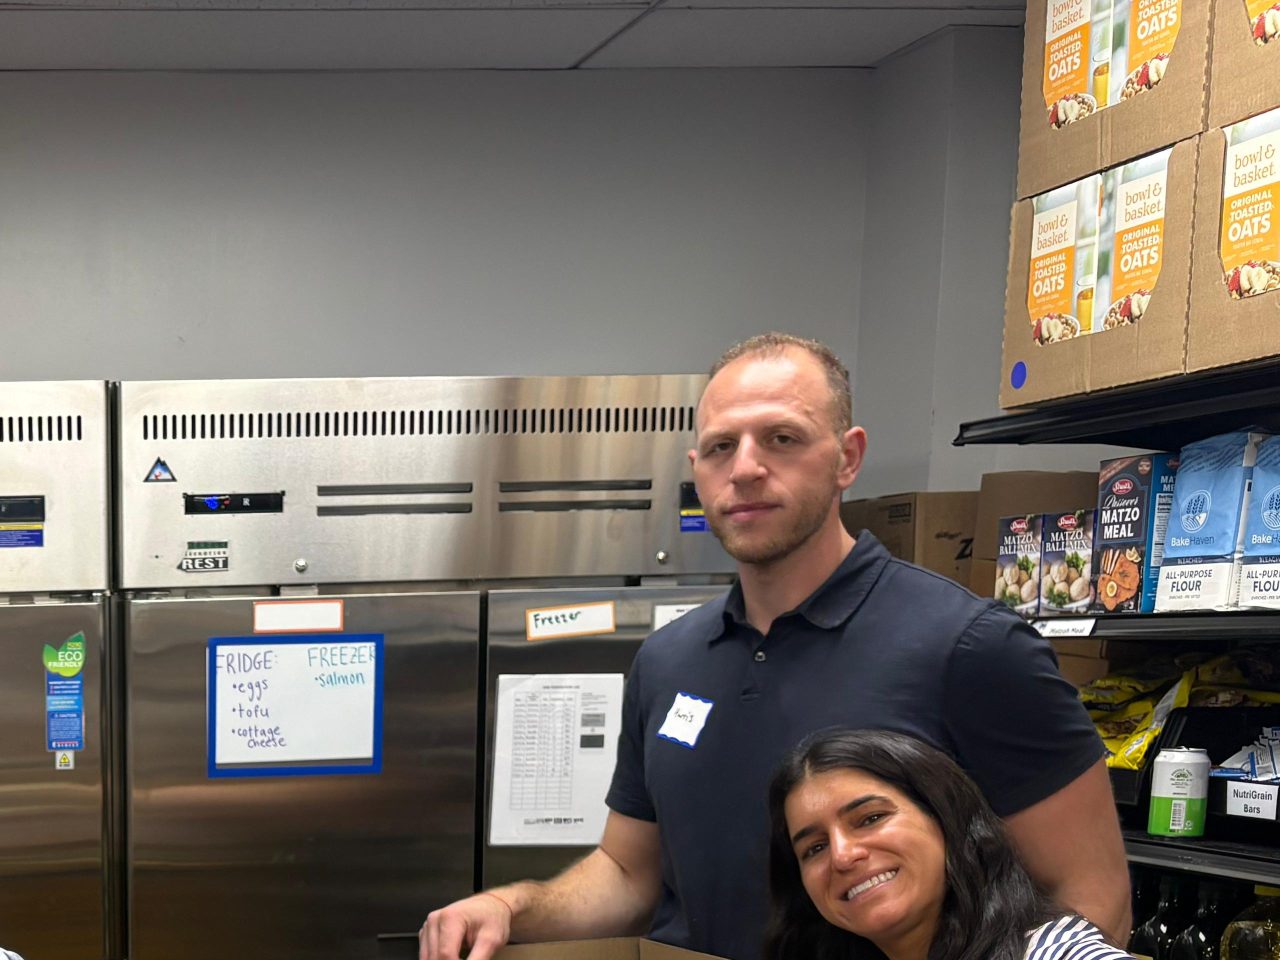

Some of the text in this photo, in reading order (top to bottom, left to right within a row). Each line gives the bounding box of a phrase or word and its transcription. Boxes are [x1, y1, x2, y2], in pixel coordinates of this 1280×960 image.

[1137, 6, 1178, 39] OATS
[1050, 31, 1081, 52] ORIGINAL
[1050, 42, 1081, 63] TOASTED
[1049, 52, 1081, 81] OATS
[1235, 143, 1275, 170] bowl &
[1125, 182, 1162, 206] bowl &
[1230, 189, 1272, 209] ORIGINAL
[1230, 200, 1272, 221] TOASTED
[1038, 214, 1068, 235] bowl &
[1122, 224, 1160, 242] ORIGINAL
[1228, 213, 1271, 242] OATS
[1121, 235, 1160, 254] TOASTED
[1034, 253, 1066, 268] ORIGINAL
[1120, 247, 1158, 273] OATS
[1034, 263, 1066, 279] TOASTED
[1033, 274, 1065, 298] OATS
[1101, 507, 1140, 524] MATZO
[1003, 534, 1033, 545] MATZO
[1050, 530, 1084, 542] MATZO
[1103, 524, 1134, 539] MEAL
[999, 544, 1017, 555] BALL
[1046, 539, 1088, 552] BALL MIX
[1165, 569, 1213, 580] ALL-PURPOSE
[1170, 580, 1202, 593] FLOUR
[533, 610, 582, 629] Freezer
[58, 651, 82, 661] ECO
[307, 645, 376, 667] FREEZER
[319, 671, 366, 688] salmon
[238, 679, 269, 702] eggs
[238, 703, 270, 718] tofu
[237, 725, 281, 739] cottage
[247, 737, 287, 749] cheese
[1233, 789, 1273, 801] NutriGrain
[1243, 804, 1261, 814] Bars
